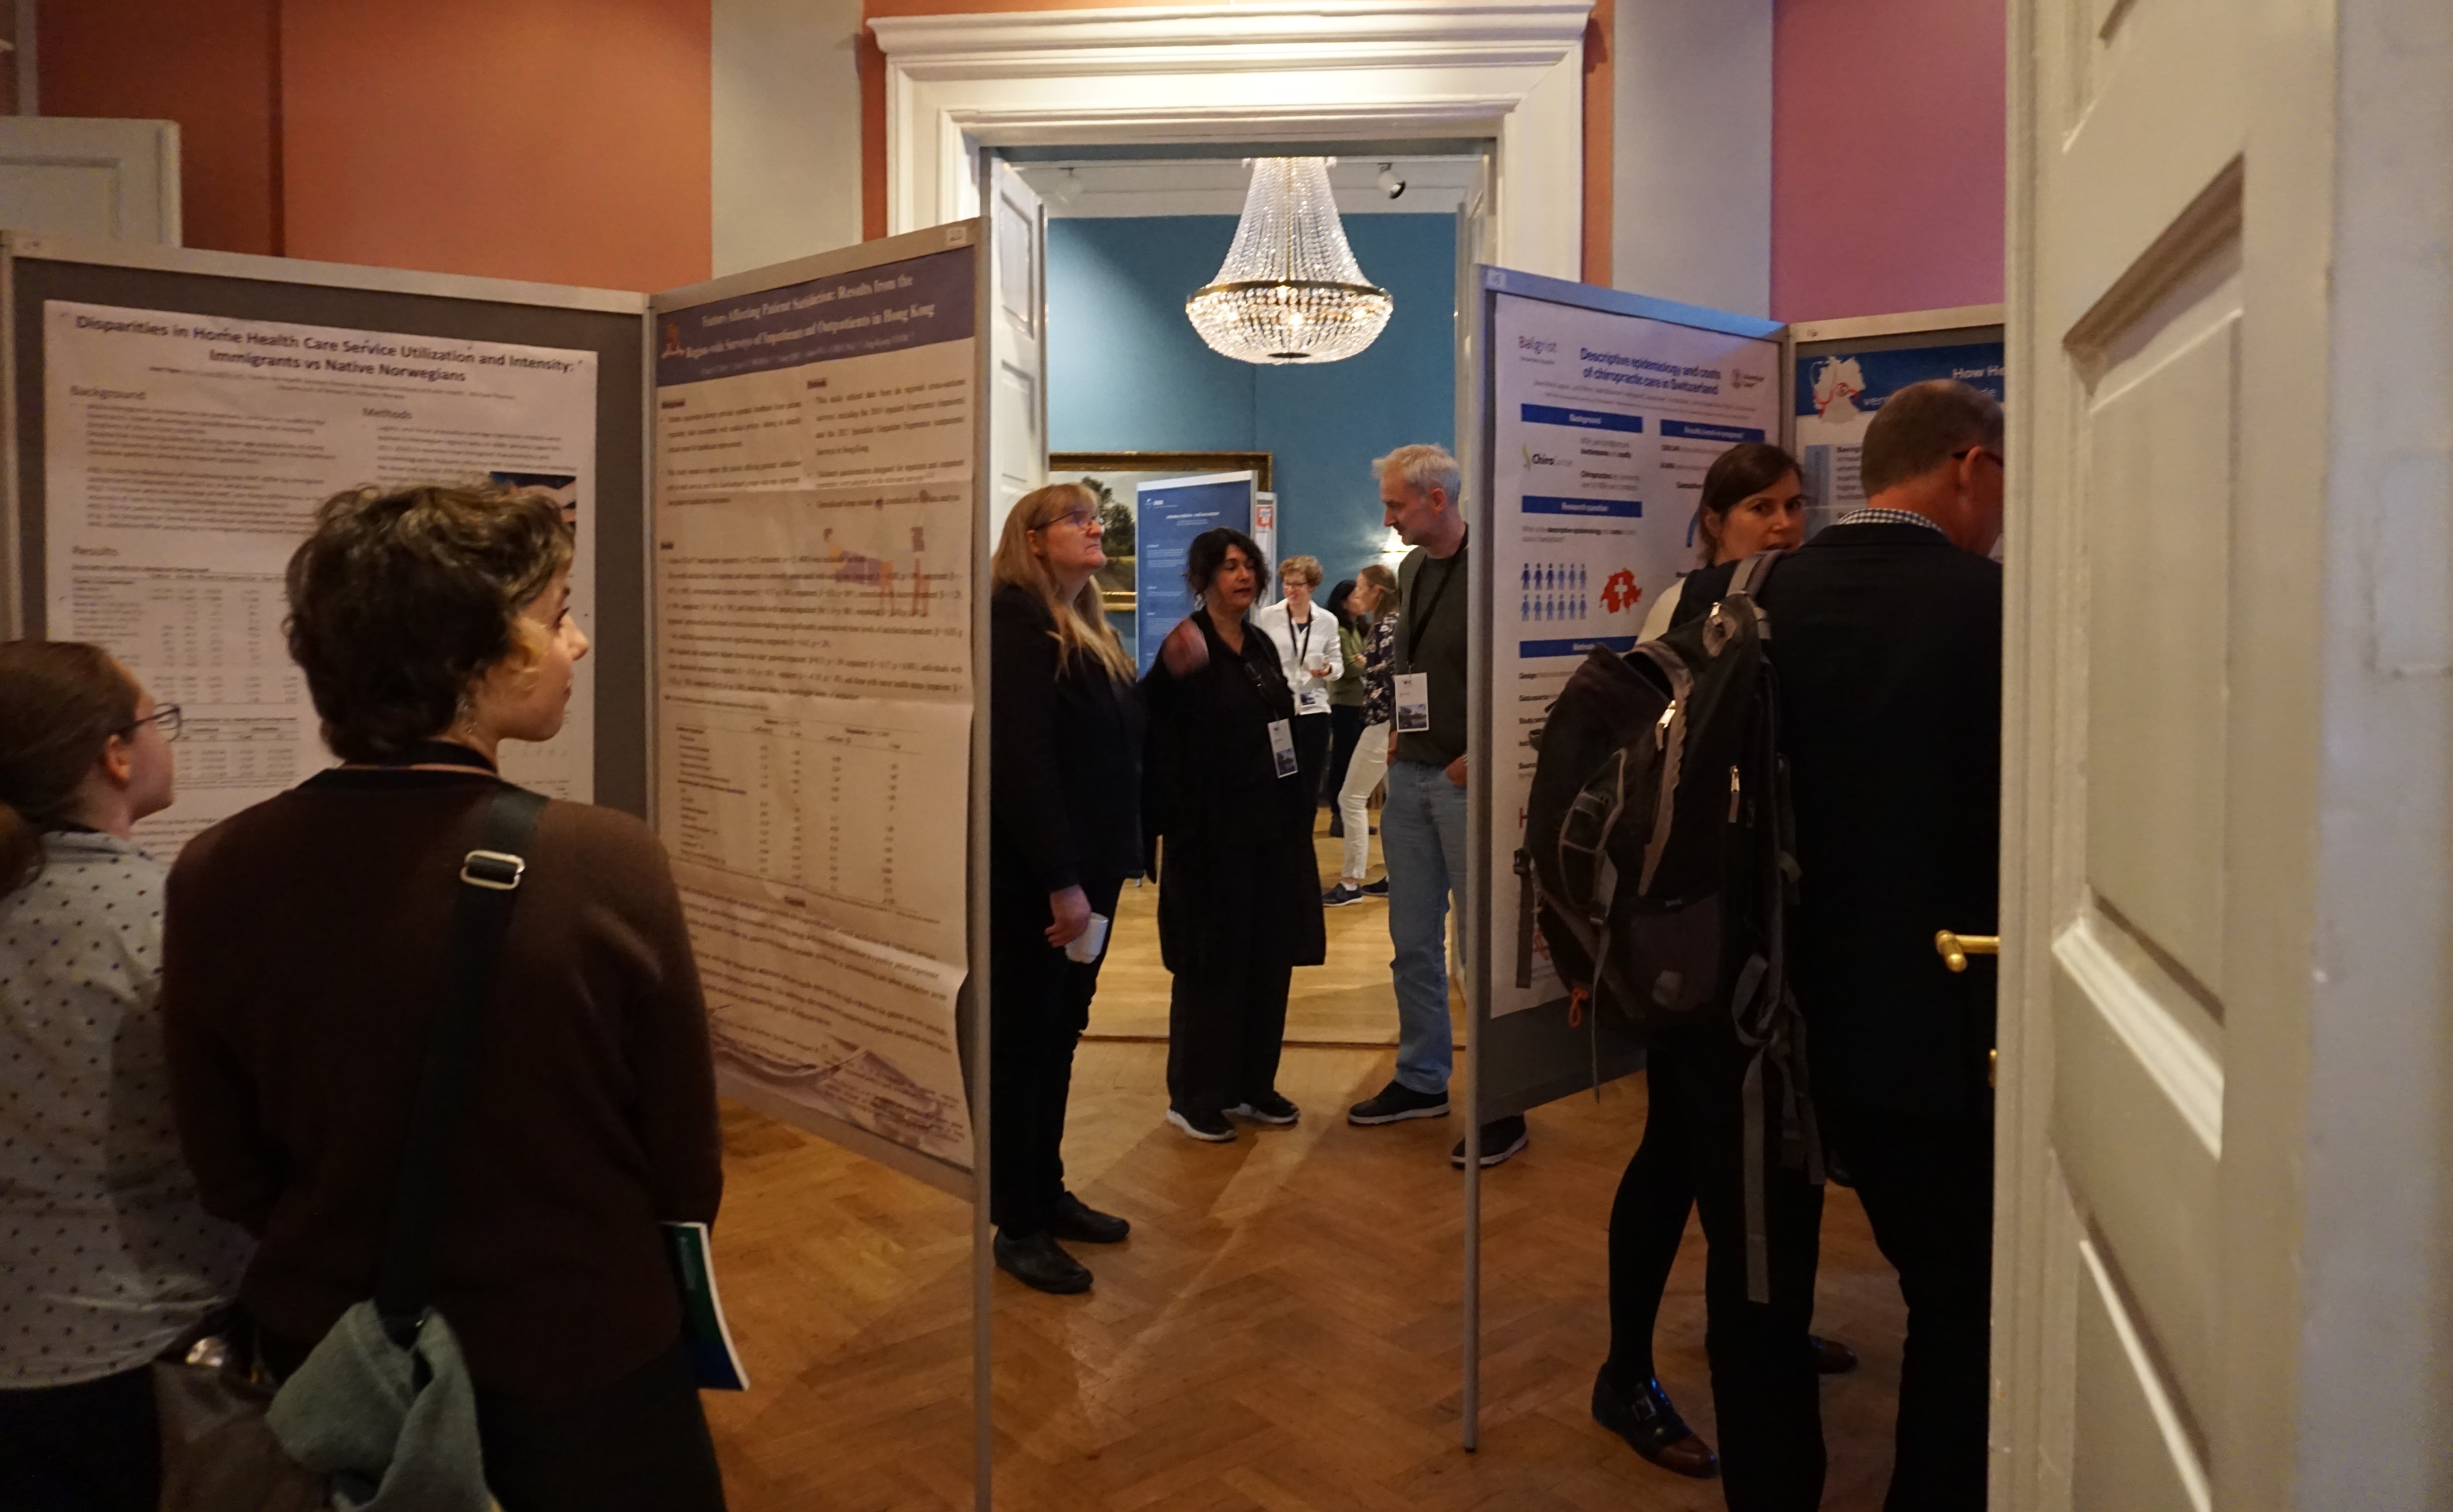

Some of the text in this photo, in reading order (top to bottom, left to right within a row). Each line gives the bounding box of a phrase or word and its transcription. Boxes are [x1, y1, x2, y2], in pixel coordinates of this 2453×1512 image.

[762, 303, 791, 315] Patient
[837, 285, 872, 299] Results
[874, 279, 896, 292] from
[897, 274, 913, 288] the
[803, 321, 817, 336] and
[871, 311, 881, 325] in
[883, 308, 908, 324] Hong
[910, 303, 935, 319] Kong
[75, 315, 168, 336] Disparities
[173, 325, 188, 337] in
[193, 326, 242, 343] Home
[246, 332, 299, 348] Health
[304, 337, 338, 352] Care
[343, 341, 396, 356] Service
[400, 345, 475, 363] Utilization
[479, 354, 505, 366] and
[209, 349, 466, 382] Immigrants vs Native Norwegians
[1580, 347, 1631, 367] Descriptive
[1631, 357, 1681, 376] epidemiology
[1682, 365, 1700, 377] and
[1952, 368, 1985, 379] How
[70, 384, 147, 400] Background
[1582, 366, 1593, 378] of
[1661, 378, 1669, 389] in
[1671, 378, 1719, 395] Switzerland
